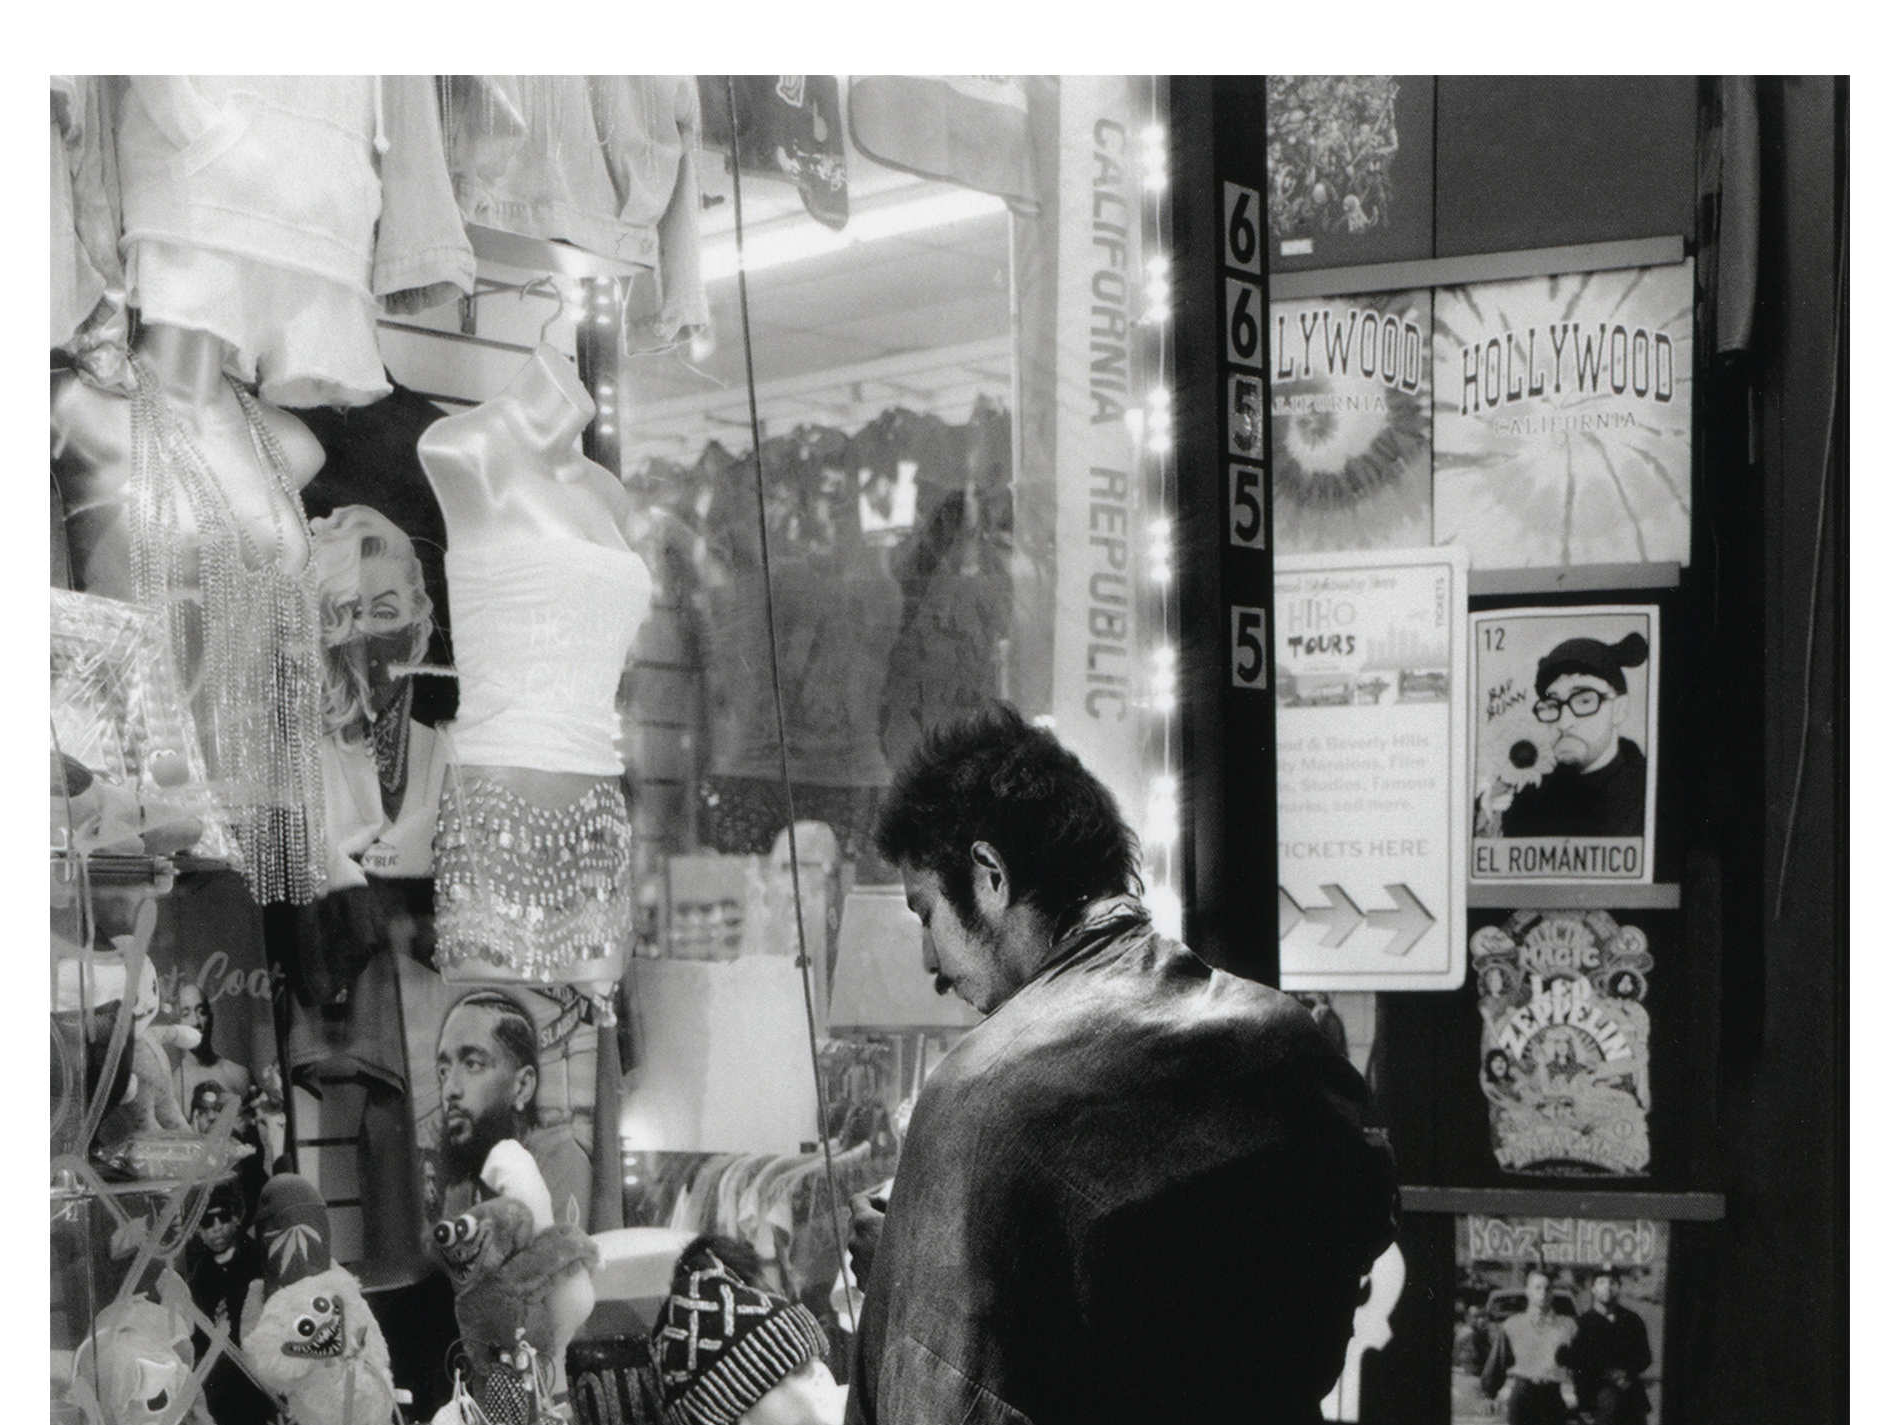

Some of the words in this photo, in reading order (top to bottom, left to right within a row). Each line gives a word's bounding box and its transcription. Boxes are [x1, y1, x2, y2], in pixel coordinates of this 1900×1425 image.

[1089, 118, 1128, 425] CALIFORNIA
[1461, 323, 1673, 415] HOLLYWOOD
[1496, 411, 1636, 437] CALIFORNIA
[1085, 466, 1128, 723] REPUBLIC
[1287, 634, 1356, 658] TOURS
[1484, 628, 1505, 651] 12
[1368, 839, 1429, 858] HERE
[1477, 847, 1499, 873] EL
[1508, 838, 1638, 873] ROMÁNTICO
[1500, 1000, 1633, 1062] ZEPPELIN
